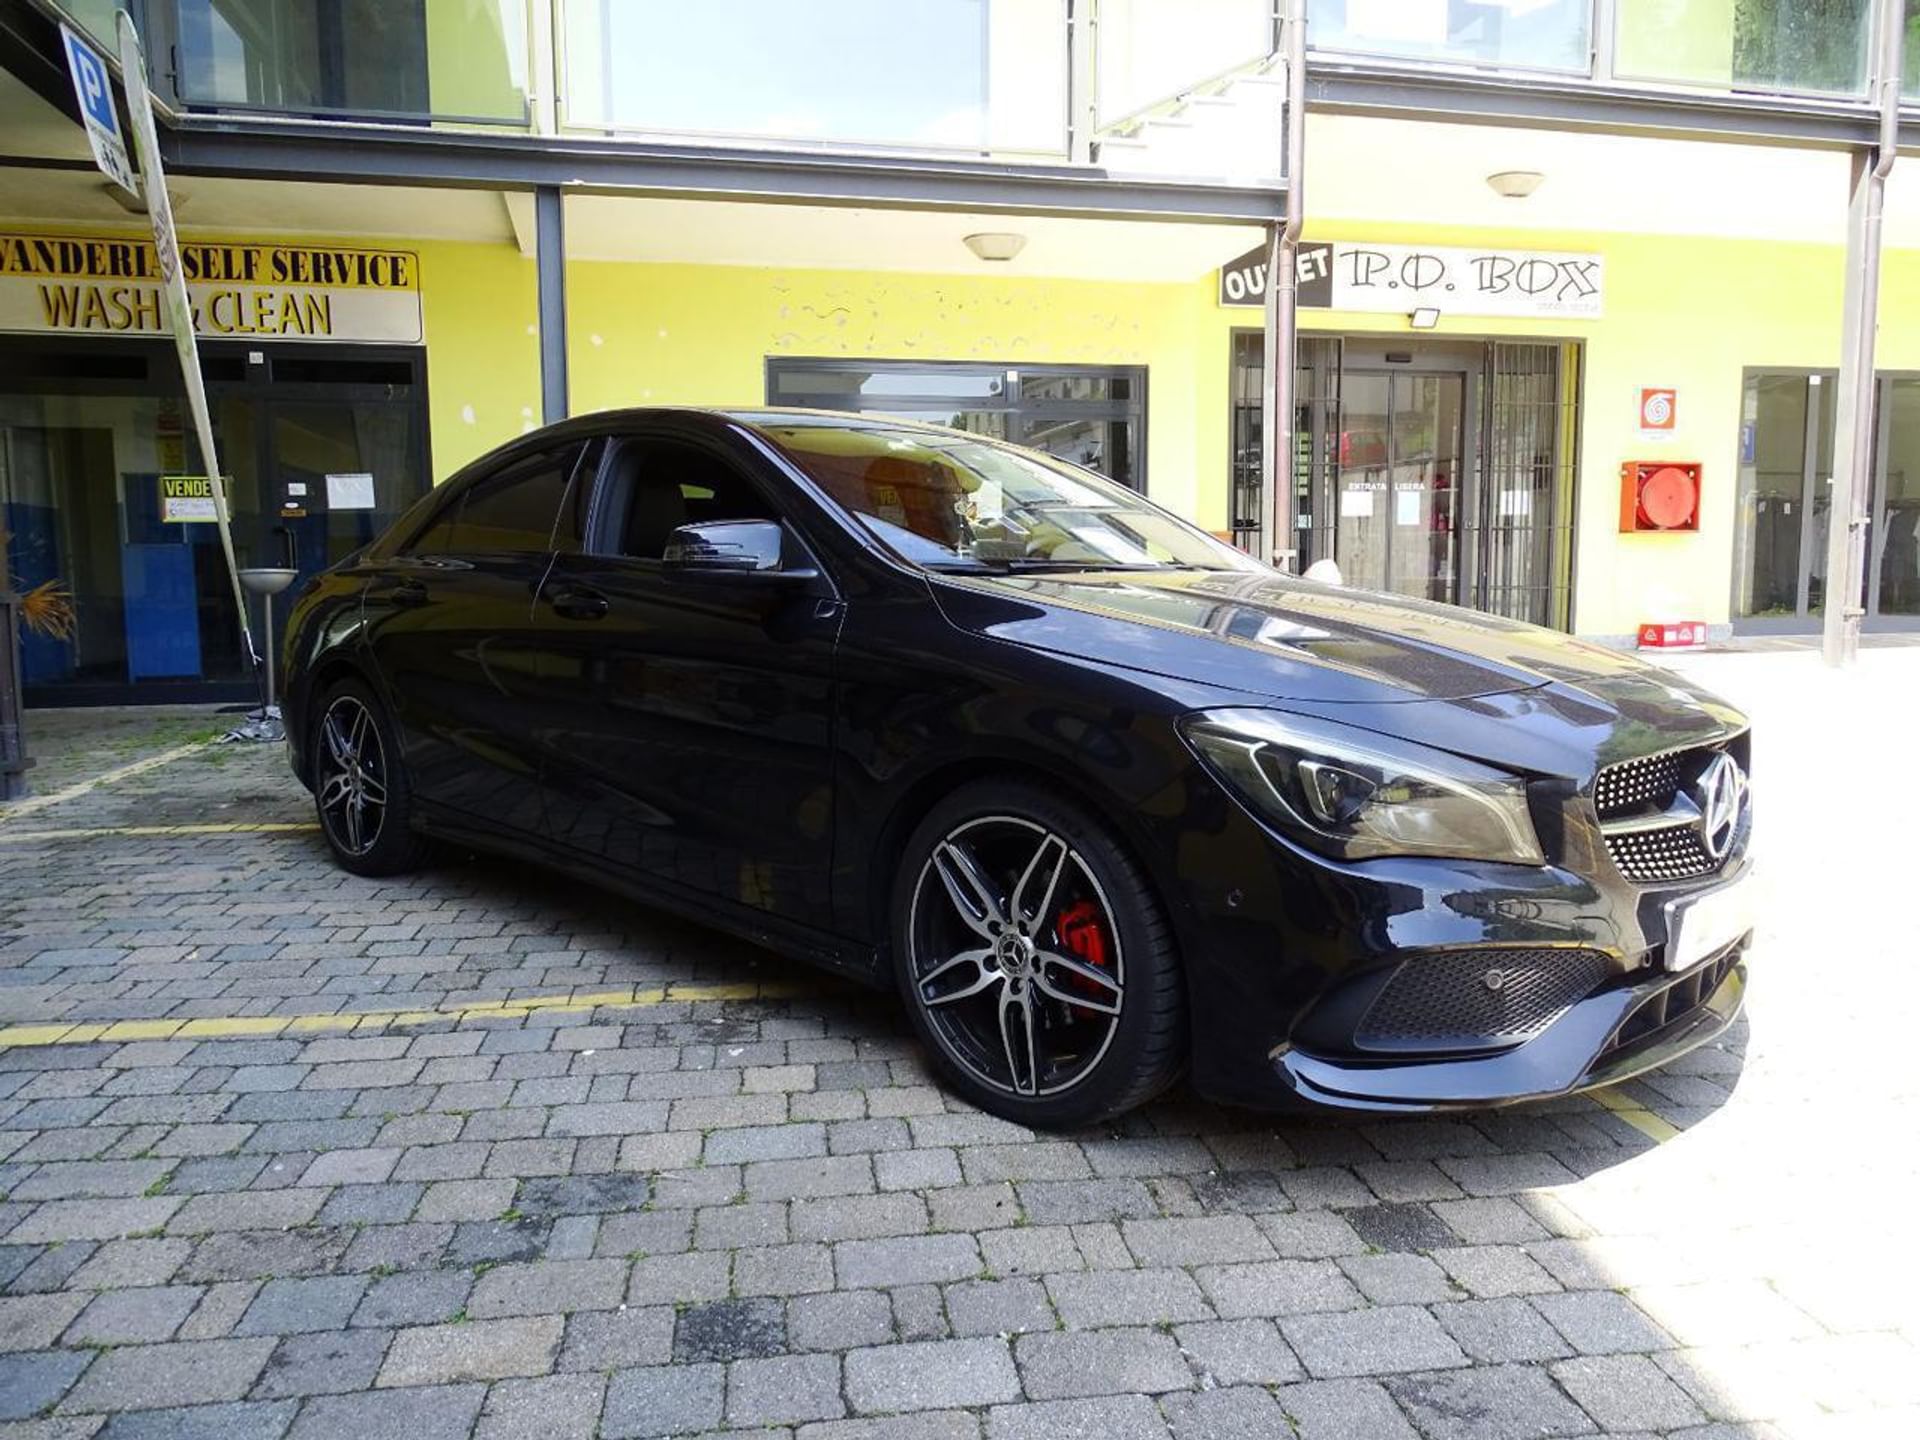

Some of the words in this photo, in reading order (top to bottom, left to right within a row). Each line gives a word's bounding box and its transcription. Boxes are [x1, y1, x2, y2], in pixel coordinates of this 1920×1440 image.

[76, 51, 102, 112] P
[182, 246, 260, 281] SELF
[271, 248, 408, 287] SERVICE
[1225, 248, 1329, 300] OUET
[1339, 250, 1455, 291] P.O.
[1470, 255, 1600, 301] BOX
[37, 284, 162, 330] WASH
[206, 290, 332, 335] CLEAN
